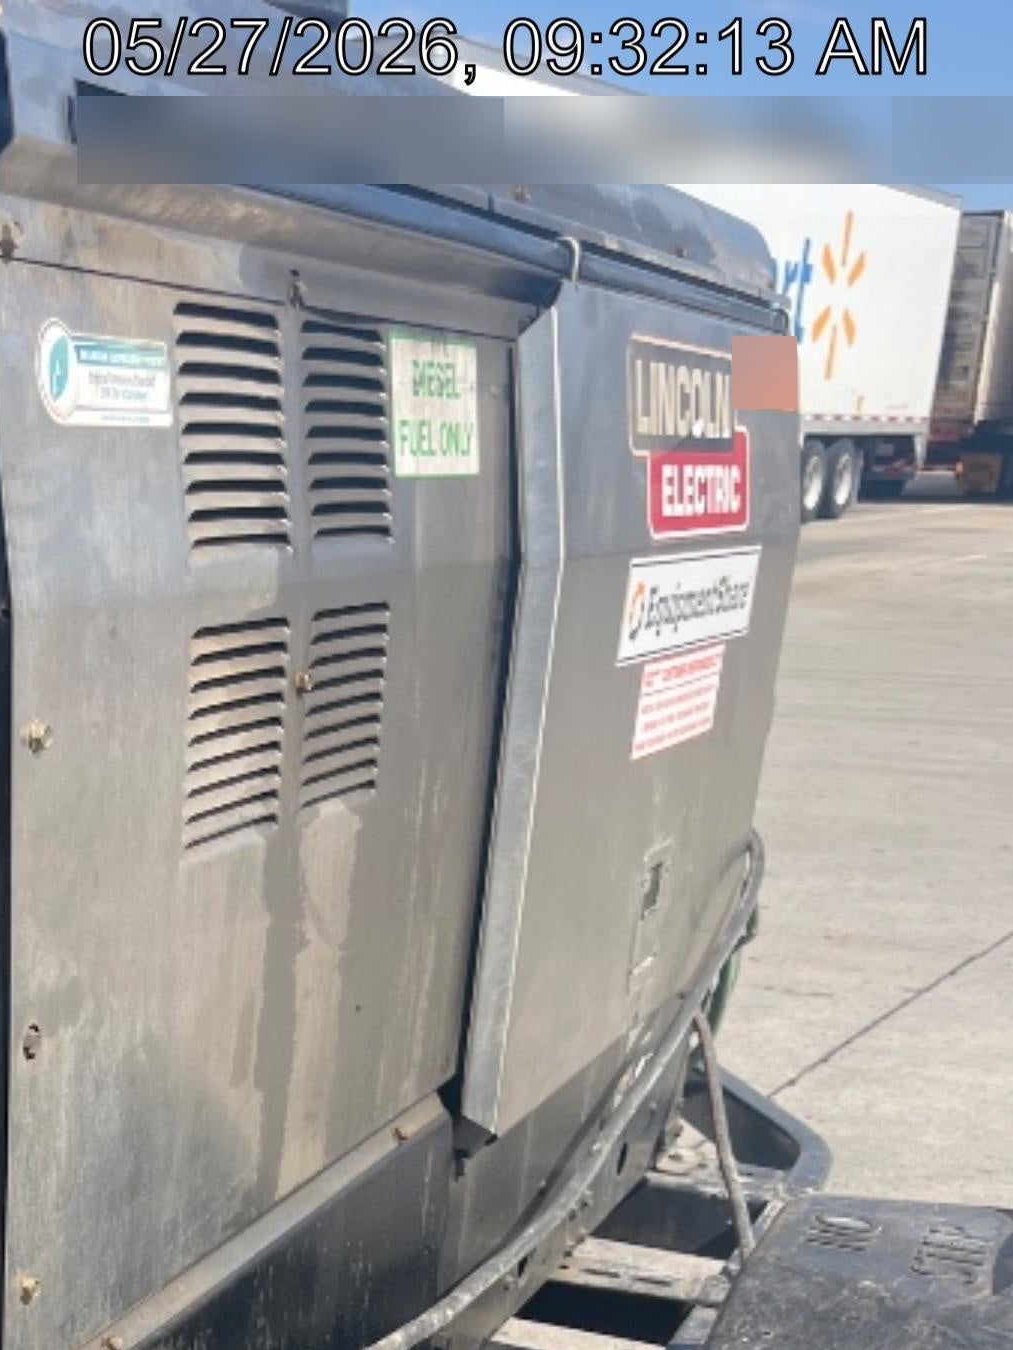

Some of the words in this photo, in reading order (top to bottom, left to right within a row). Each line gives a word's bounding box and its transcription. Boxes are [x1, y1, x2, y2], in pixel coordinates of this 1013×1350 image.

[412, 360, 461, 400] DIESEL
[634, 358, 731, 439] LINCOLN
[399, 419, 437, 457] FUEL
[440, 420, 474, 458] ONLY
[661, 462, 742, 518] ELECTRIC
